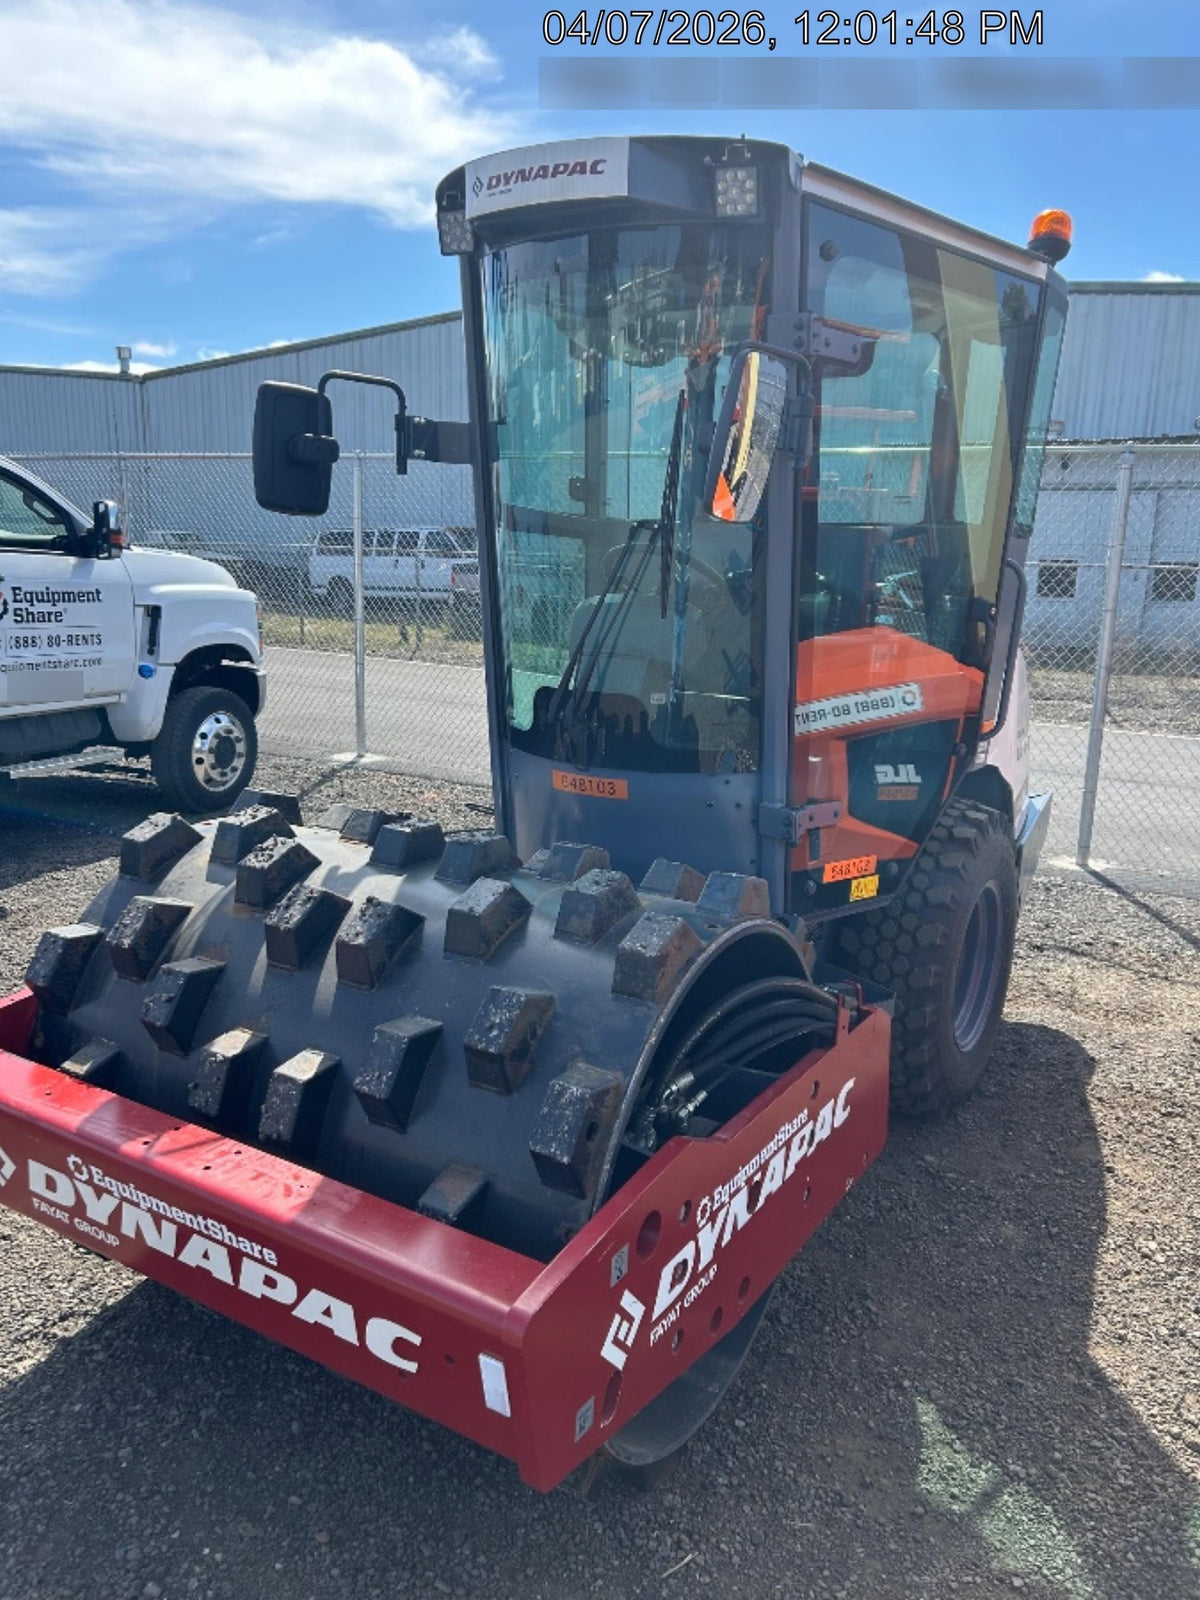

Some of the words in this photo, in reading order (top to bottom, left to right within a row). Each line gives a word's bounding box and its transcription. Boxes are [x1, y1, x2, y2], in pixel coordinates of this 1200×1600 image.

[486, 158, 606, 191] DYNAPAC
[11, 586, 103, 607] Equipment
[13, 607, 63, 623] Share
[47, 633, 102, 648] 80-RENTS
[712, 1108, 809, 1211] EquipmentShare
[32, 1197, 70, 1225] FAYAT
[73, 1217, 120, 1248] GROUP
[89, 1164, 279, 1267] EquipmentShare
[651, 1076, 857, 1322] DYNAPAC
[27, 1158, 422, 1374] DYNAPAC
